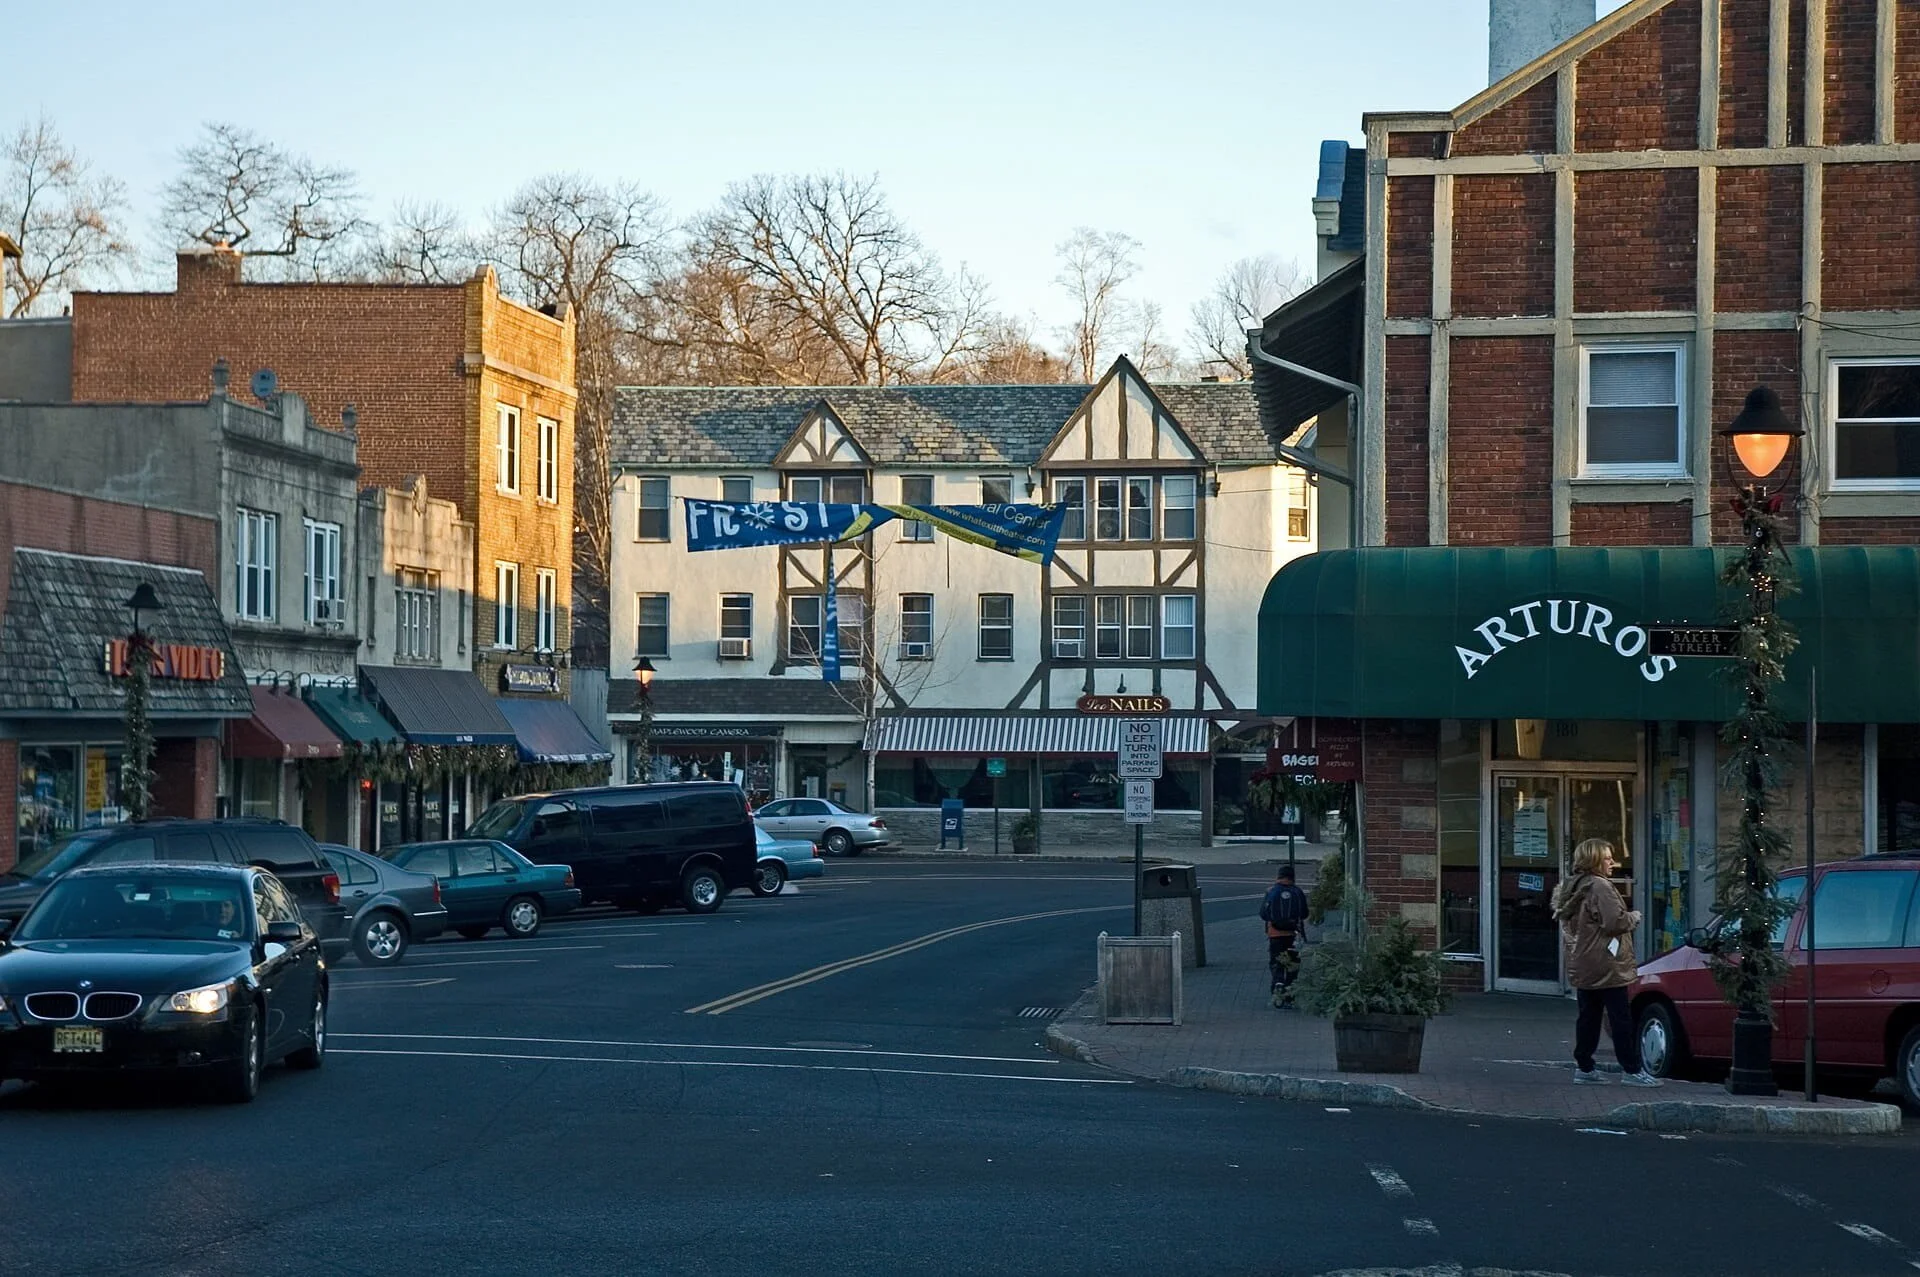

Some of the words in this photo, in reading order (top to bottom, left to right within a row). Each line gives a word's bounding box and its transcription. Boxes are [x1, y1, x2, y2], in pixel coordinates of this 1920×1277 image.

[1455, 599, 1677, 682] ARTUROS
[1673, 633, 1720, 643] BAKER
[1670, 643, 1721, 653] STREET
[169, 644, 221, 681] VIDEO
[1109, 698, 1163, 711] NAILS
[649, 727, 707, 736] MAPLEWOOD
[710, 727, 750, 736] CAMERA
[1129, 723, 1151, 733] NO
[1125, 734, 1155, 743] LEFT
[1124, 743, 1156, 752] TURN
[1133, 785, 1145, 794] NO
